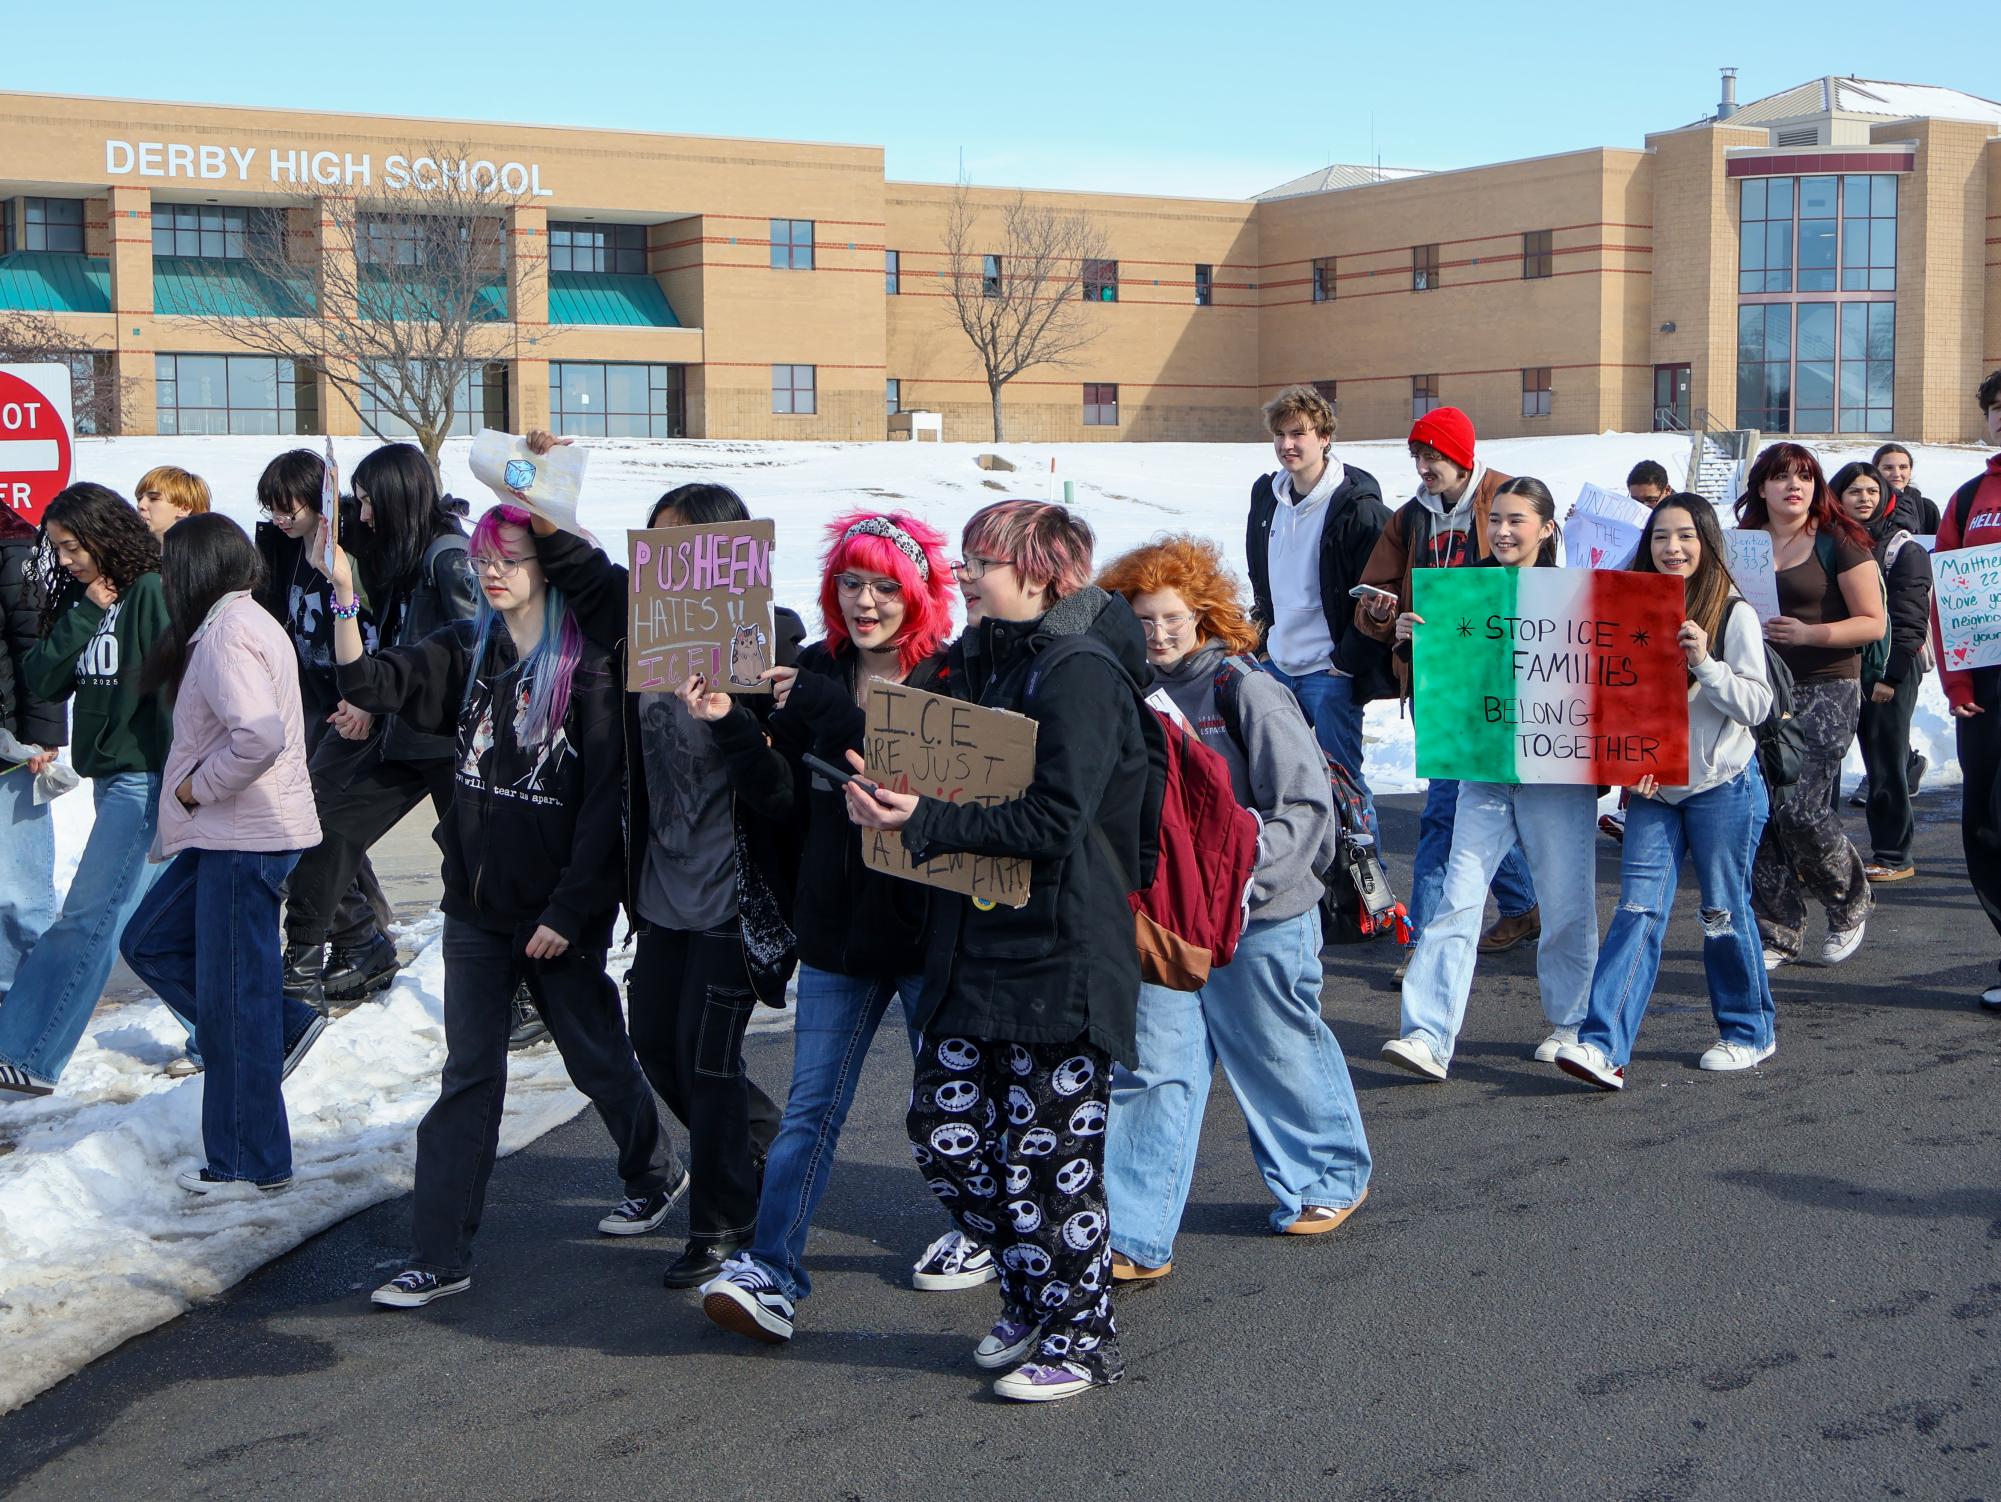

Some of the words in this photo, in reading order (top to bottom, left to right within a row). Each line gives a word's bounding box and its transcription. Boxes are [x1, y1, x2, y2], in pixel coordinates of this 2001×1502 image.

[106, 139, 256, 181] DERBY
[270, 149, 370, 185] HIGH
[384, 155, 553, 197] SCHOOL
[1591, 520, 1622, 547] THE
[635, 533, 770, 595] PUSHEEN
[1980, 571, 1999, 587] 22
[635, 596, 719, 648] HATES
[1485, 614, 1556, 642] STOP
[1567, 619, 1620, 648] ICE
[1512, 651, 1638, 687] FAMILIES
[1484, 696, 1598, 727] BELONG
[865, 737, 903, 776] ARE
[912, 745, 1005, 784] JUST
[1516, 733, 1660, 764] TOGETHER
[464, 778, 485, 790] will
[494, 785, 517, 798] tear
[873, 831, 891, 866] A
